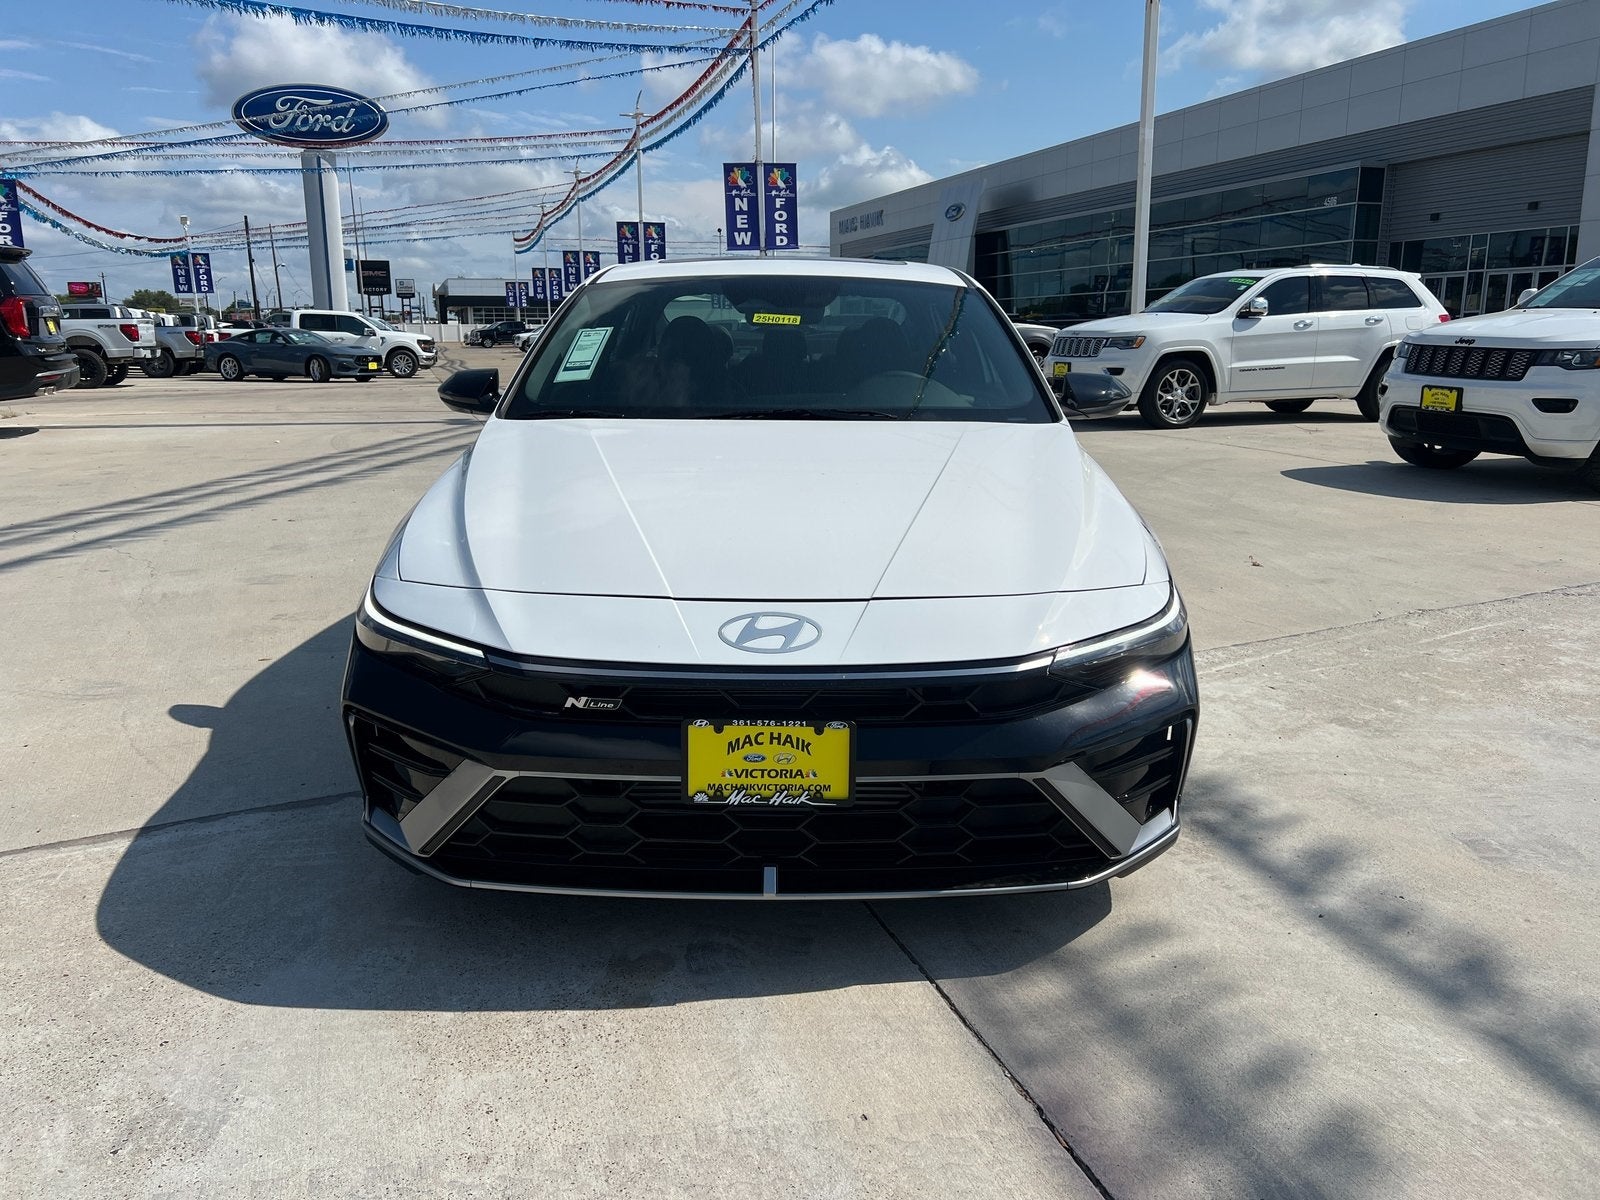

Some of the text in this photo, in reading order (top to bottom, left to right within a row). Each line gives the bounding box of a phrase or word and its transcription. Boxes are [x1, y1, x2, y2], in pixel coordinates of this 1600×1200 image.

[268, 95, 356, 133] Ford
[0, 211, 14, 245] FOR
[733, 197, 752, 246] NEW
[774, 198, 788, 246] FORD
[623, 244, 633, 263] NE
[177, 268, 188, 291] NEW
[199, 268, 209, 292] FORD
[568, 267, 578, 290] NEW
[508, 291, 516, 307] NEW
[536, 280, 544, 299] NEW
[755, 315, 798, 323] 25H0118
[1454, 337, 1475, 345] Jeep
[732, 719, 807, 727] 361-576-1221
[726, 731, 812, 756] MAC HAIK
[733, 768, 805, 779] VICTORIA
[707, 783, 831, 792] MACHAIKVICTORIA.COM
[725, 789, 812, 806] Mac Haik
